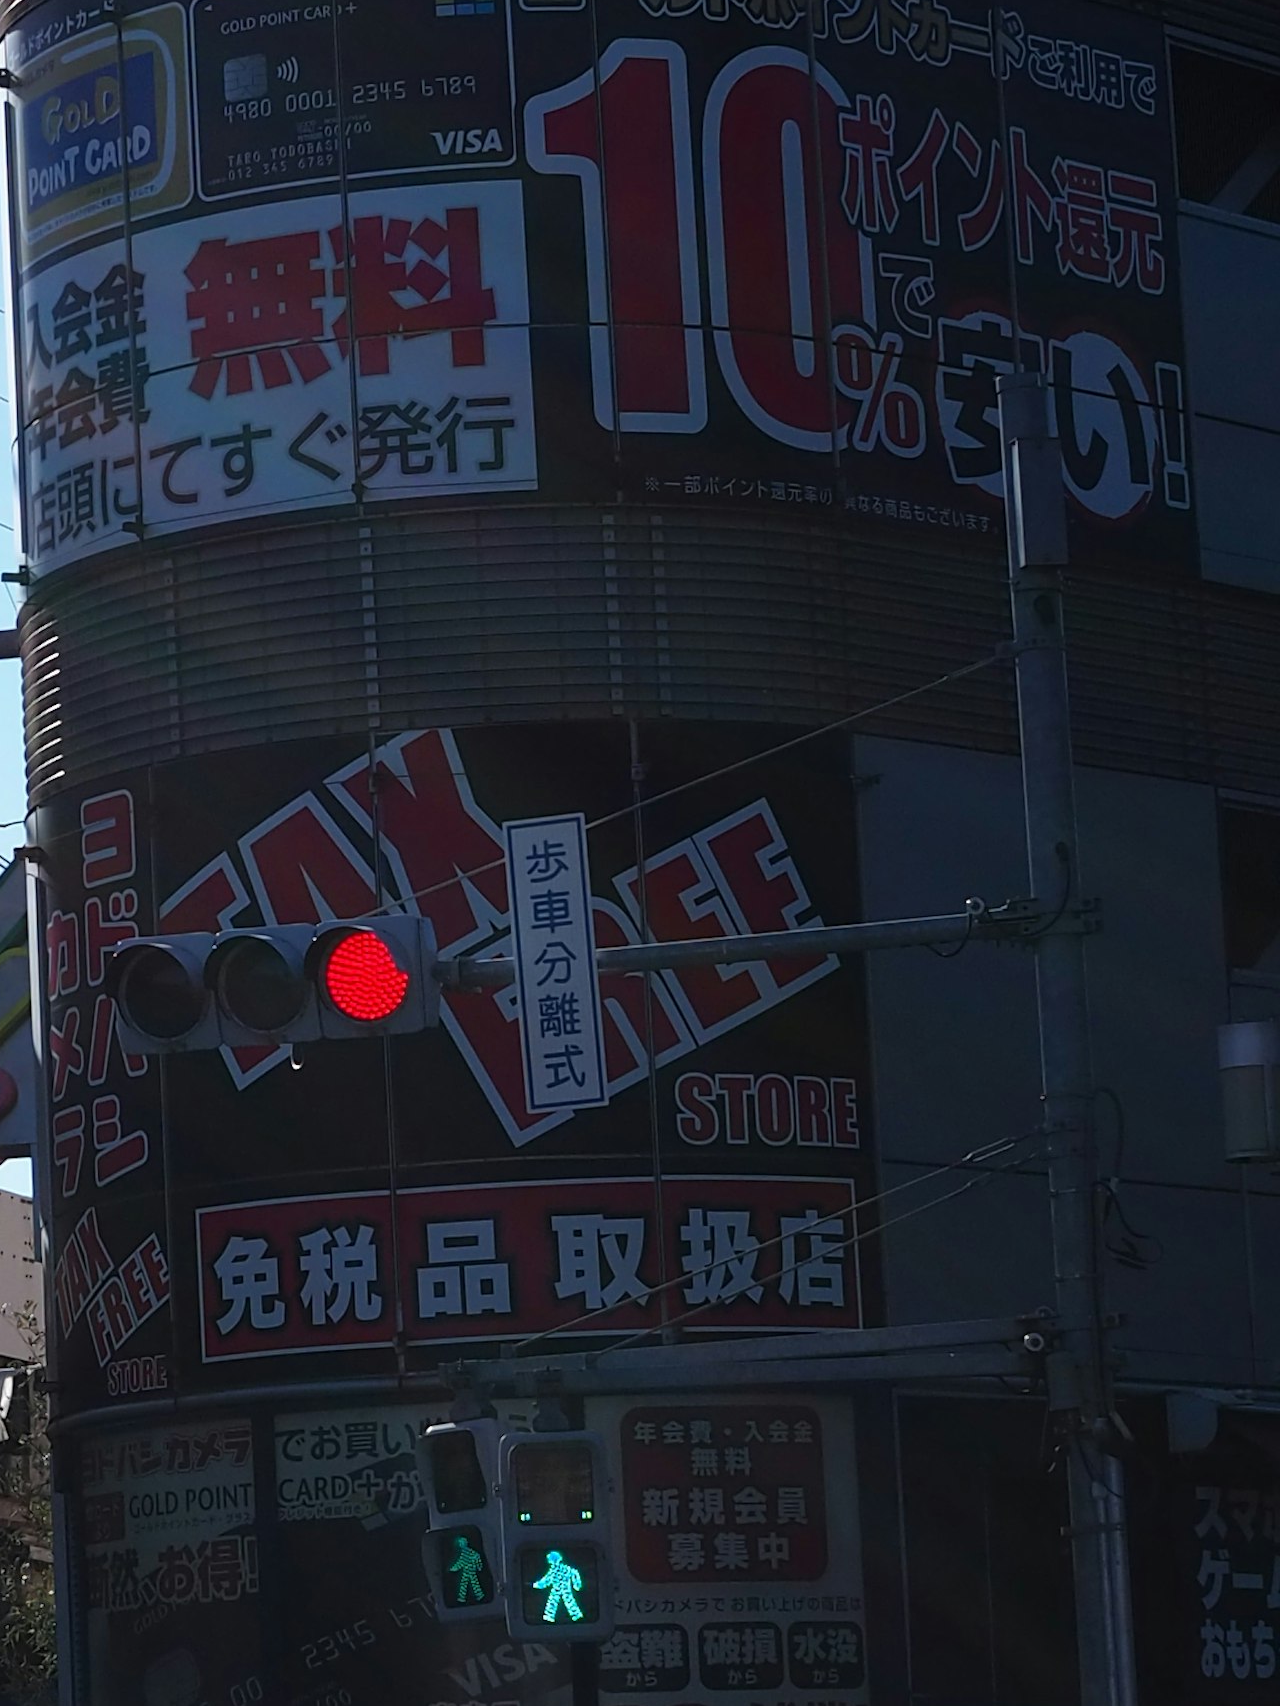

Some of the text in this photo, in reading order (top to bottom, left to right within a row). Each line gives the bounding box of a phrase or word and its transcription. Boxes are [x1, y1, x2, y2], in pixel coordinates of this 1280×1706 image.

[220, 17, 256, 35] GOLD
[259, 11, 300, 28] POINT
[40, 75, 124, 146] GOLD
[223, 74, 478, 124] 4980 0001 2345 6789
[430, 127, 505, 156] VISA
[27, 144, 81, 207] POINT
[842, 93, 1166, 295] ポイント還元
[26, 263, 148, 380] 入会金
[184, 205, 499, 401] 無料
[28, 346, 152, 463] 年会費
[32, 395, 516, 559] 店頭にてすぐ発行
[525, 840, 587, 1090] 歩車分離式
[45, 907, 87, 1199] カメラ
[675, 1071, 861, 1151] STORE
[55, 1205, 114, 1341] TAX
[212, 1204, 846, 1336] 免税品取扱店
[84, 1231, 172, 1368] FREE
[105, 1354, 168, 1397] STORE
[633, 1420, 815, 1445] 年会費・入会金
[690, 1446, 754, 1477] 無料
[128, 1492, 180, 1521] GOLD
[184, 1482, 253, 1514] POINT
[641, 1486, 810, 1527] 新規会員
[666, 1531, 792, 1572] 募集中
[300, 1618, 377, 1670] 2345
[600, 1629, 685, 1670] 盗難
[703, 1628, 779, 1667] 破損
[793, 1627, 860, 1666] 水没
[446, 1643, 559, 1699] VISA
[626, 1671, 659, 1687] から
[727, 1670, 758, 1685] から
[812, 1669, 840, 1684] から
